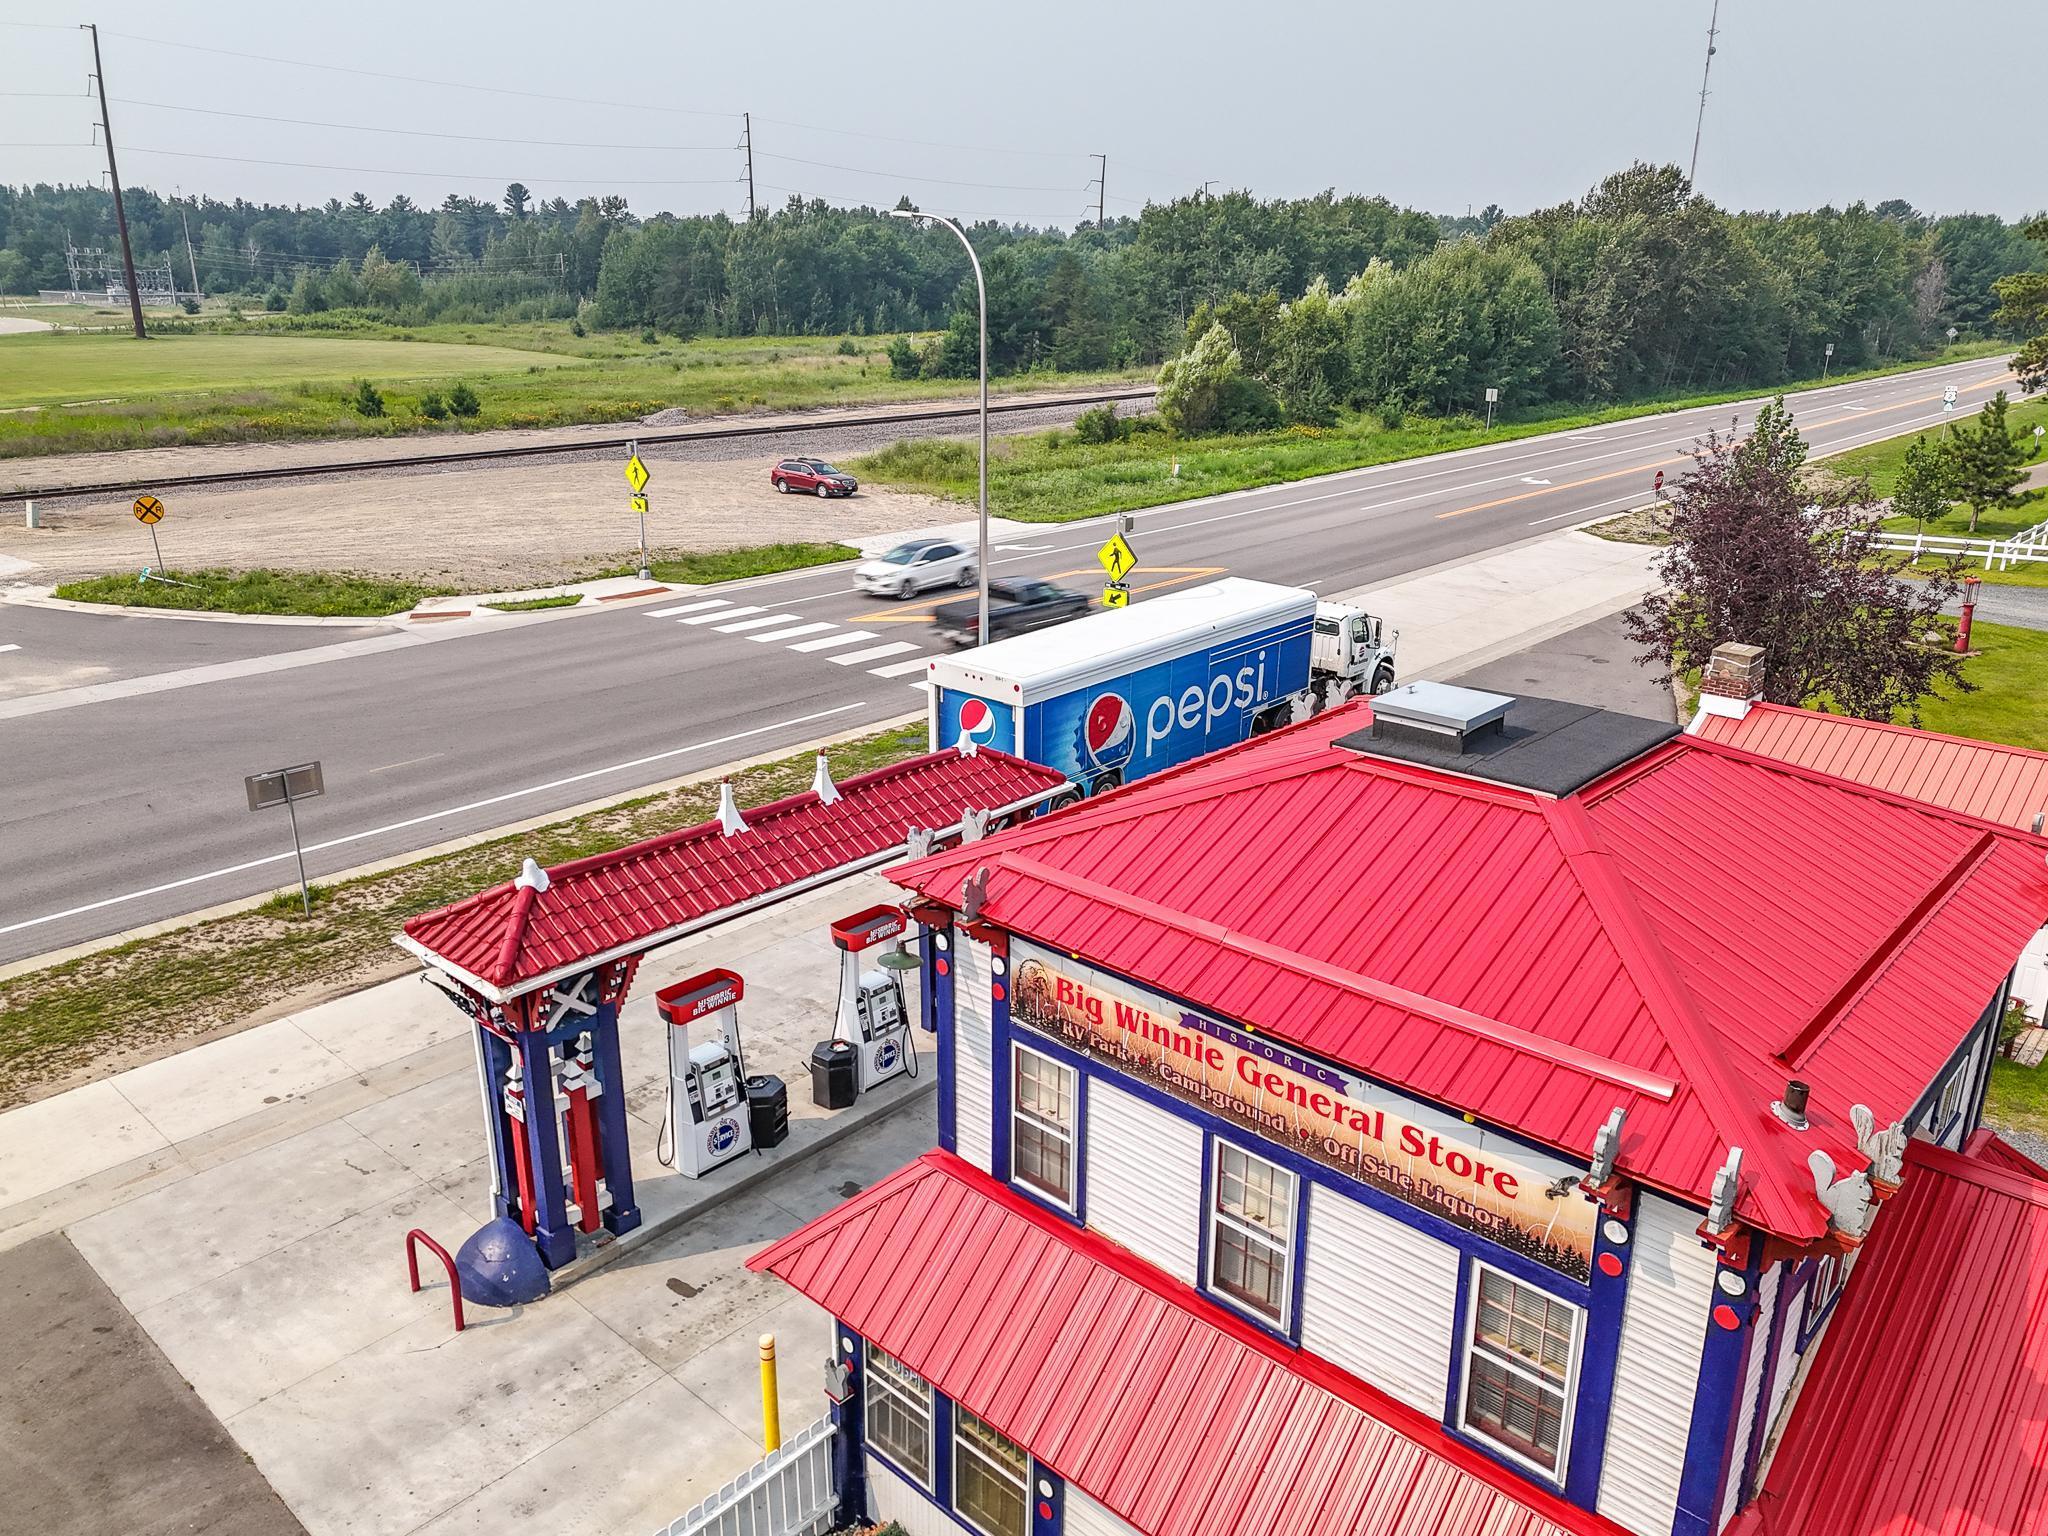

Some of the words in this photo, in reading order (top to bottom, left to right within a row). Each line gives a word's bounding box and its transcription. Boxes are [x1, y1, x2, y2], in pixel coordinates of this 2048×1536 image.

[1146, 650, 1266, 758] pepsi
[870, 920, 899, 937] HISTORIC
[877, 924, 902, 939] WINNIE
[692, 1006, 706, 1017] BIG
[707, 991, 737, 1010] WINNIE
[697, 988, 733, 1008] HISTORIC
[724, 1035, 730, 1044] 3
[1198, 1019, 1328, 1081] HISTORIC
[1056, 976, 1104, 1026] Big
[1114, 1000, 1224, 1072] Winnie
[1236, 1055, 1385, 1142] General
[1399, 1125, 1520, 1200] Store
[1062, 1021, 1086, 1042] RV
[1089, 1033, 1129, 1062] Park
[1158, 1063, 1287, 1133] Campground
[1323, 1137, 1361, 1166] Off
[1363, 1153, 1415, 1190] Sale
[1420, 1178, 1505, 1230] Liquor
